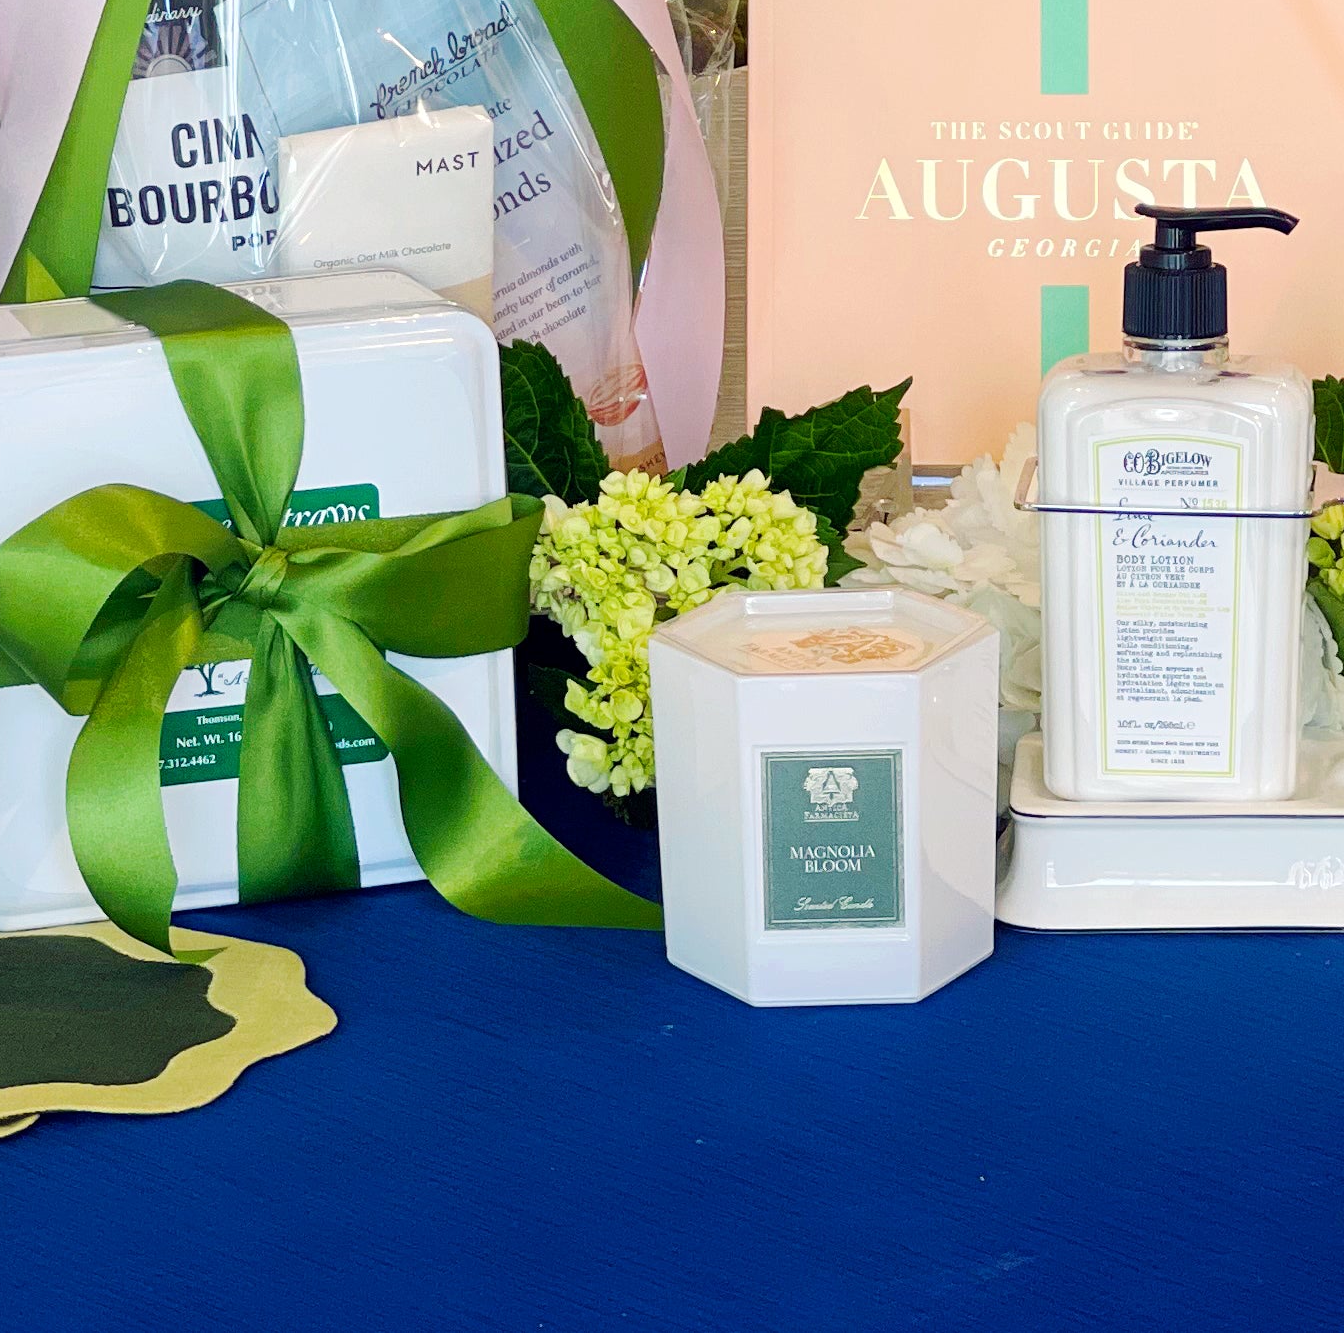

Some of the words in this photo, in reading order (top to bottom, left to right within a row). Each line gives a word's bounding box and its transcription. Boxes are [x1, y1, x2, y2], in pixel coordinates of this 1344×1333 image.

[370, 46, 447, 120] french
[449, 0, 516, 64] broad
[931, 121, 987, 140] THE
[998, 121, 1091, 140] SCOUT
[416, 151, 480, 176] MAST
[854, 157, 1268, 221] AUGUSTA
[313, 255, 355, 269] Organic
[357, 251, 377, 263] Oat
[378, 247, 400, 260] Milk
[401, 241, 452, 258] Chocolate
[987, 238, 1141, 258] GEORGIA
[517, 257, 560, 286] almonds
[560, 242, 583, 262] with
[518, 285, 544, 307] layer
[545, 275, 557, 293] of
[517, 317, 528, 329] in
[528, 306, 545, 323] our
[545, 273, 602, 313] bean-to-bar
[541, 304, 587, 337] chocolate
[1118, 479, 1161, 487] VILLAGE
[1165, 479, 1219, 488] PERFUMER
[1132, 523, 1218, 549] Coriander
[1116, 554, 1145, 565] BODY
[1151, 555, 1195, 566] LOTION
[1117, 565, 1147, 573] LOTION
[1188, 566, 1215, 574] CORPS
[1130, 573, 1162, 581] CITRON
[1152, 581, 1201, 589] CORIANDRE
[1116, 619, 1130, 627] Our
[1116, 634, 1163, 643] lightweight
[1156, 650, 1171, 658] and
[196, 712, 243, 726] Thomson,
[229, 731, 242, 743] 16
[814, 803, 849, 813] ANTICA
[802, 811, 860, 821] FARMACISTA
[789, 844, 876, 861] MAGNOLIA
[804, 858, 862, 873] BLOOM
